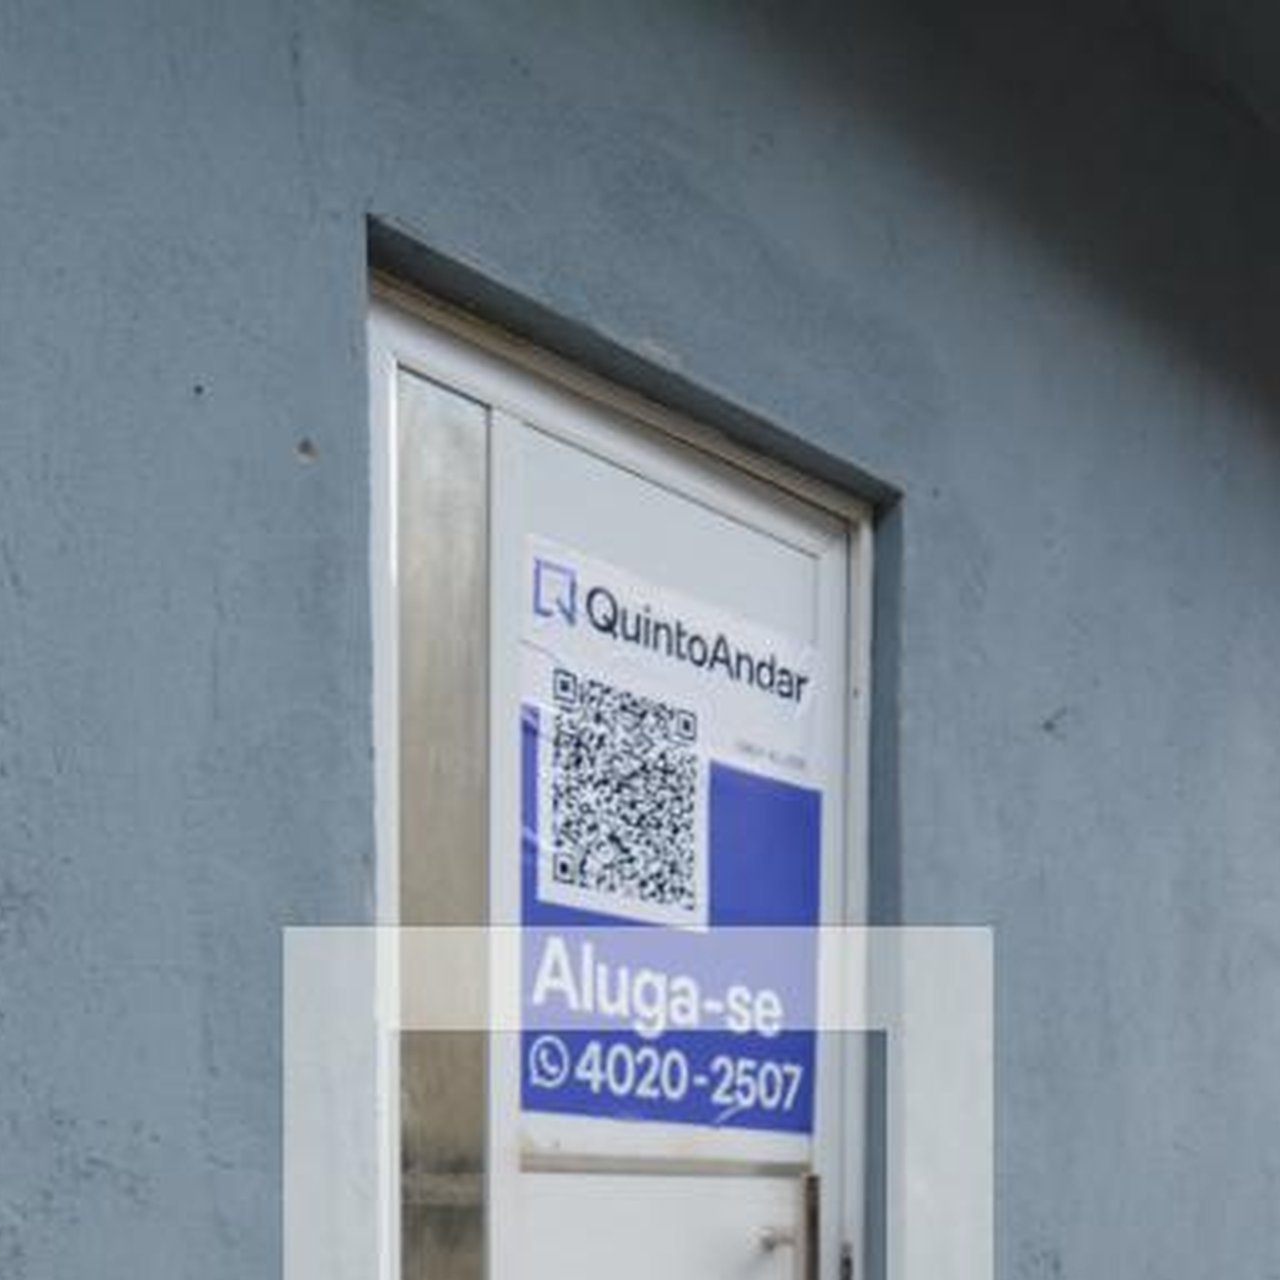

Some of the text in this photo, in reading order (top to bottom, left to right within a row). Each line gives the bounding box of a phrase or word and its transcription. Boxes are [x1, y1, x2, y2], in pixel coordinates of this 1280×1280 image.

[585, 586, 810, 703] QuintoAndar
[531, 935, 784, 1038] Aluga-se
[574, 1041, 805, 1112] 4020-2507
